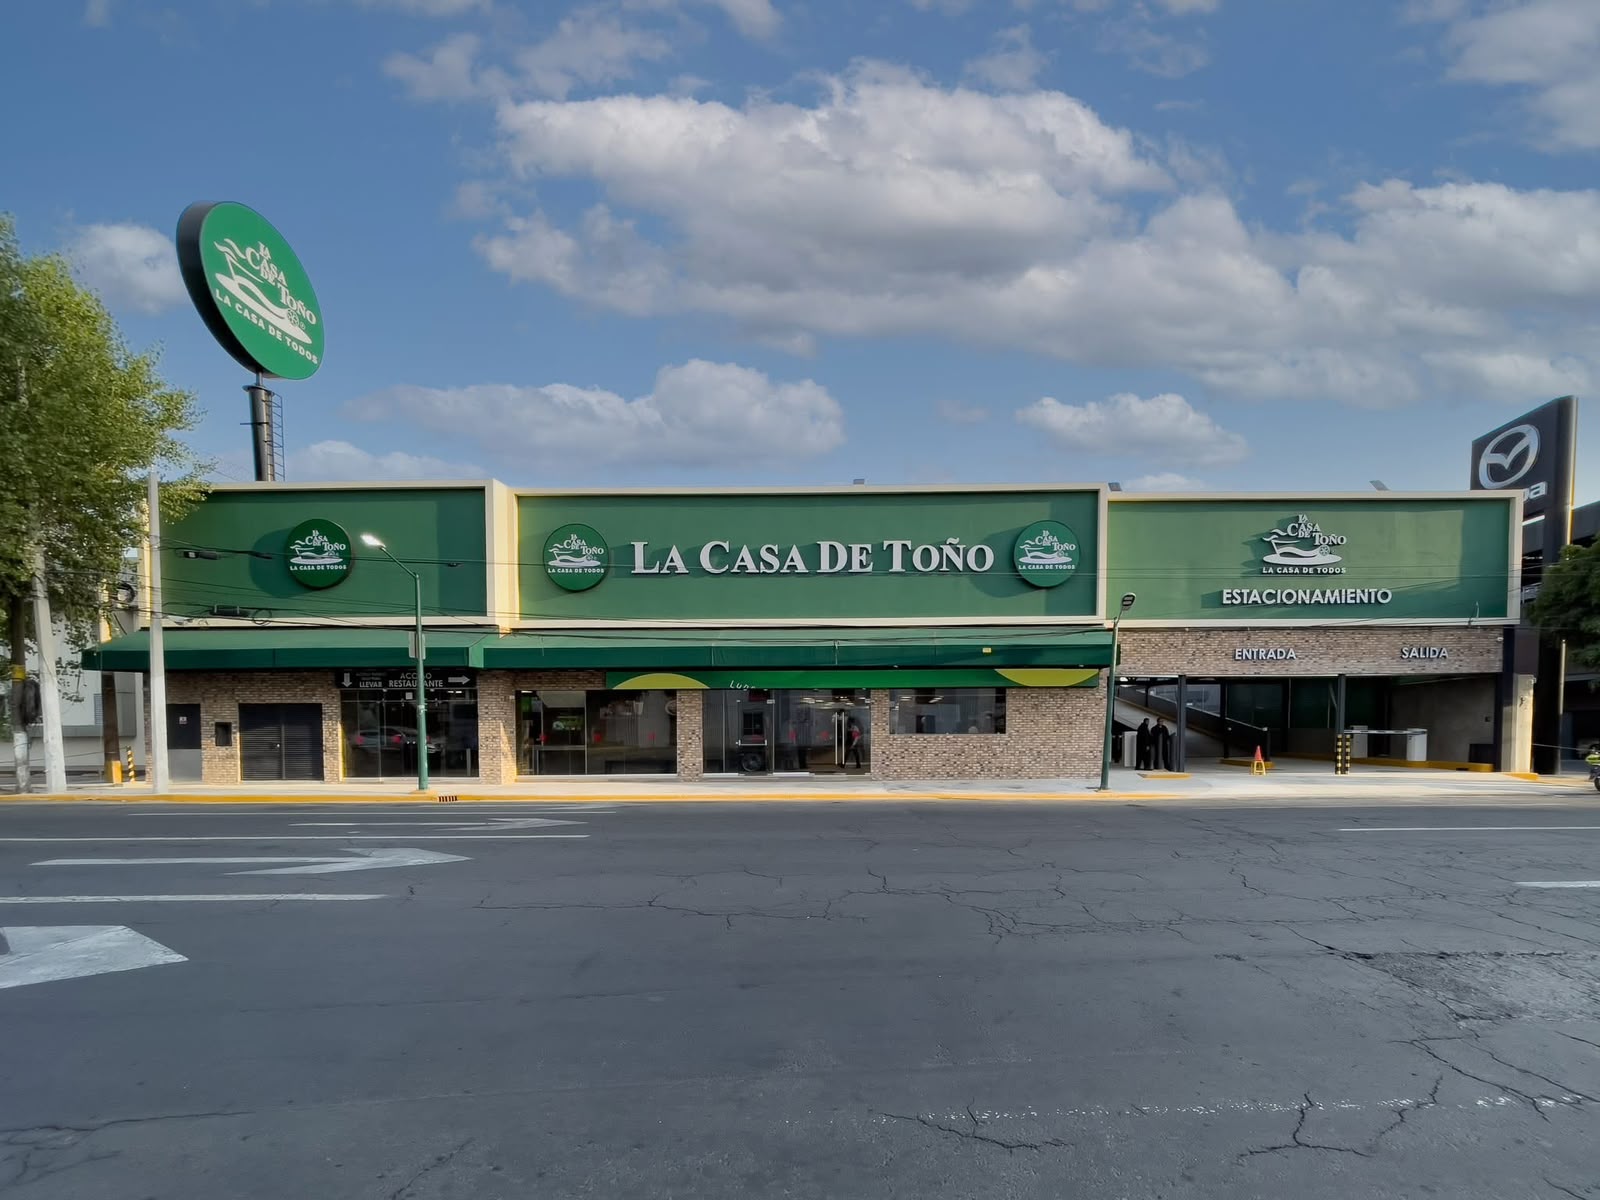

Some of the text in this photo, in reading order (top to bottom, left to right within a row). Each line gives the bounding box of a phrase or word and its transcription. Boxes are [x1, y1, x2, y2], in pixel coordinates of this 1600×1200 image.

[258, 241, 271, 260] LA
[245, 247, 287, 287] CASA
[277, 282, 316, 325] TOÑO
[215, 289, 318, 365] LA CASA DE TODOS
[1298, 514, 1308, 523] LA
[1287, 523, 1321, 536] CASA
[305, 536, 328, 545] CASA
[564, 540, 586, 548] CASA
[1035, 536, 1058, 545] CASA
[1312, 533, 1347, 545] TOÑO
[322, 542, 346, 551] TOÑO
[581, 546, 604, 555] TOÑO
[1052, 542, 1076, 551] TOÑO
[630, 537, 995, 575] LA CASA DE TOÑO
[1222, 588, 1392, 605] ESTACIONAMIENTO
[1235, 648, 1297, 660] ENTRADA
[1401, 647, 1449, 659] SALIDA
[400, 672, 432, 680] ACCO
[388, 680, 444, 688] RESTAUANTE
